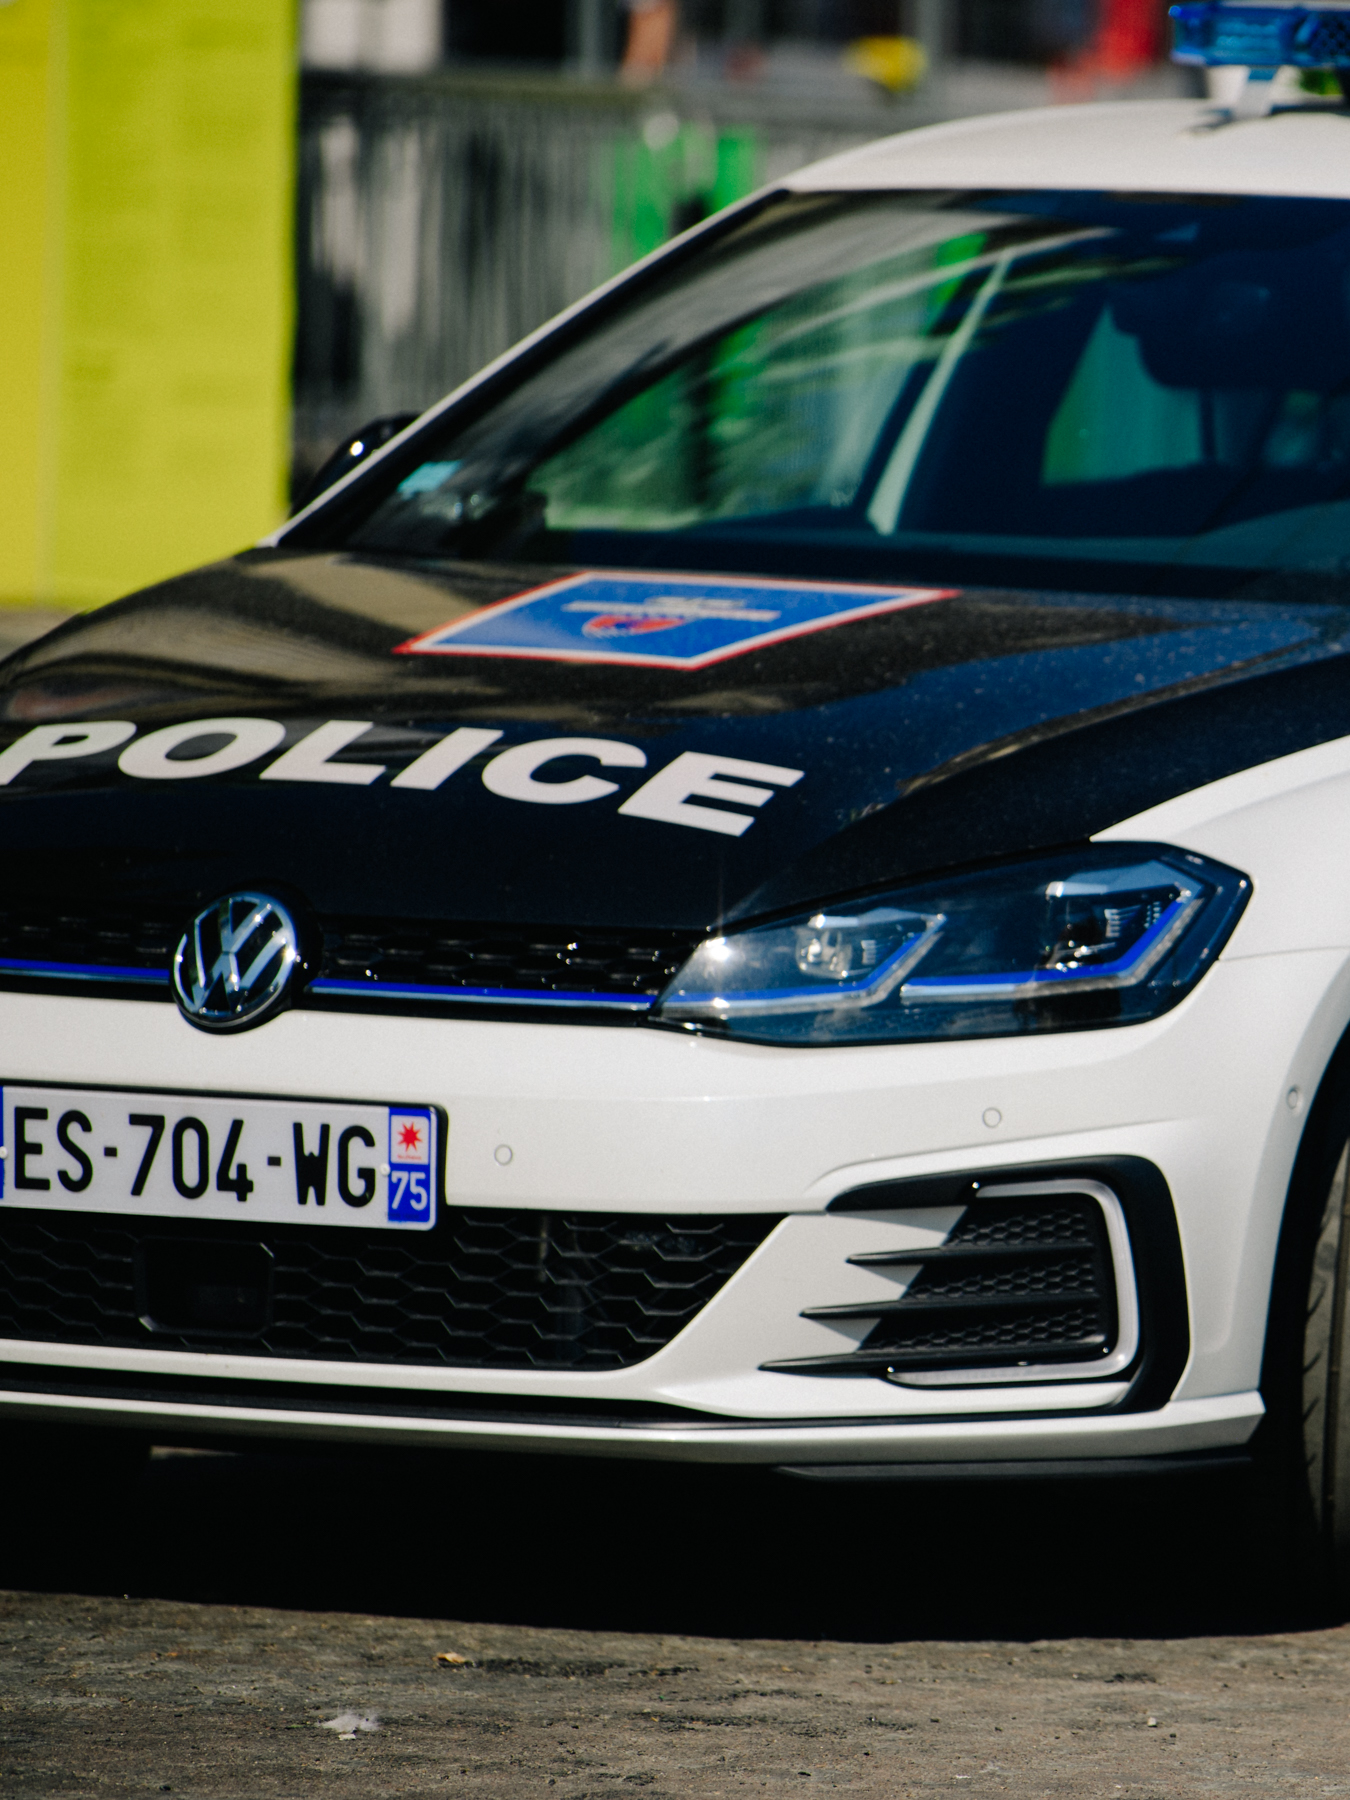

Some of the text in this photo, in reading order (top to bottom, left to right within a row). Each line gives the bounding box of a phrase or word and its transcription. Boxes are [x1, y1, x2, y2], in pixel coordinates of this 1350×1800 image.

[0, 717, 804, 838] POLICE
[14, 1105, 376, 1209] ES-704-WG
[390, 1170, 429, 1212] 75
